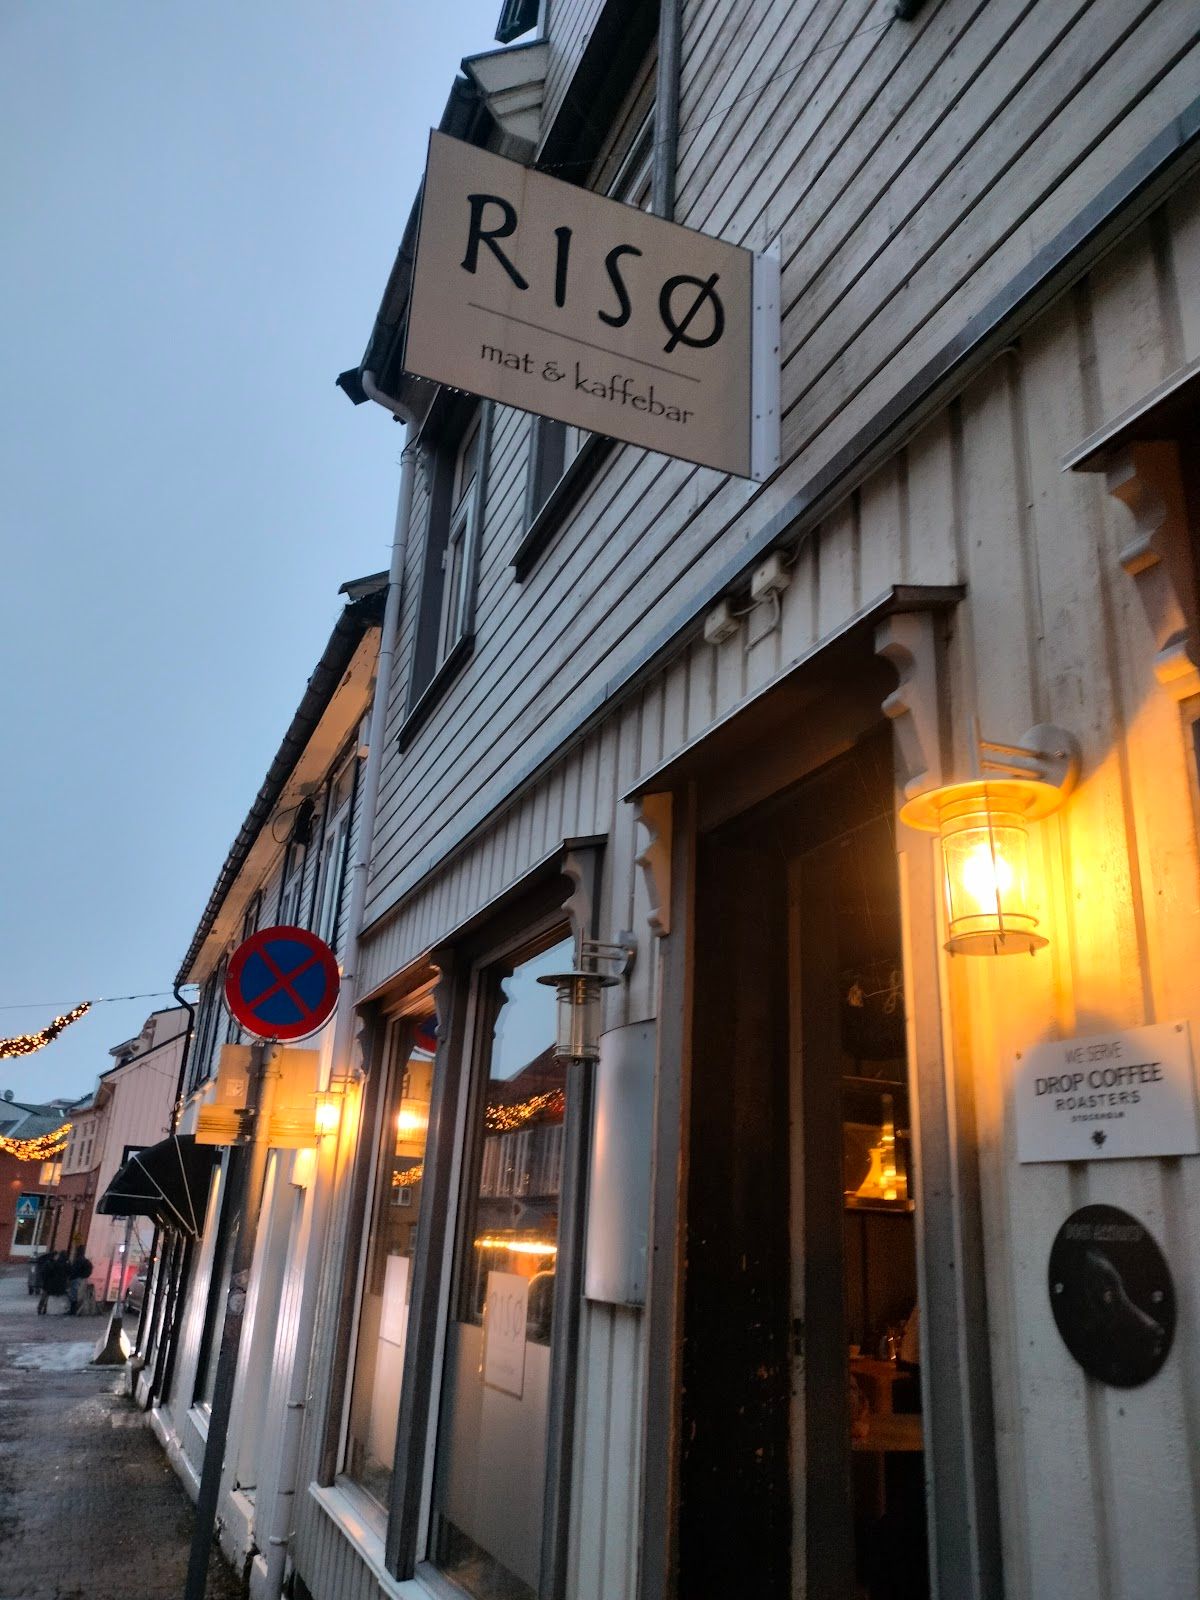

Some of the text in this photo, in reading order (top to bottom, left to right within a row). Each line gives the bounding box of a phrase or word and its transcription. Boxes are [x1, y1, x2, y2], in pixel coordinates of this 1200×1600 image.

[460, 193, 725, 353] RISØ
[480, 343, 694, 425] mat & kaffebar
[1065, 1041, 1122, 1064] WE SERVE
[1035, 1062, 1163, 1095] DROP COFFEE
[1056, 1090, 1141, 1110] ROASTERS
